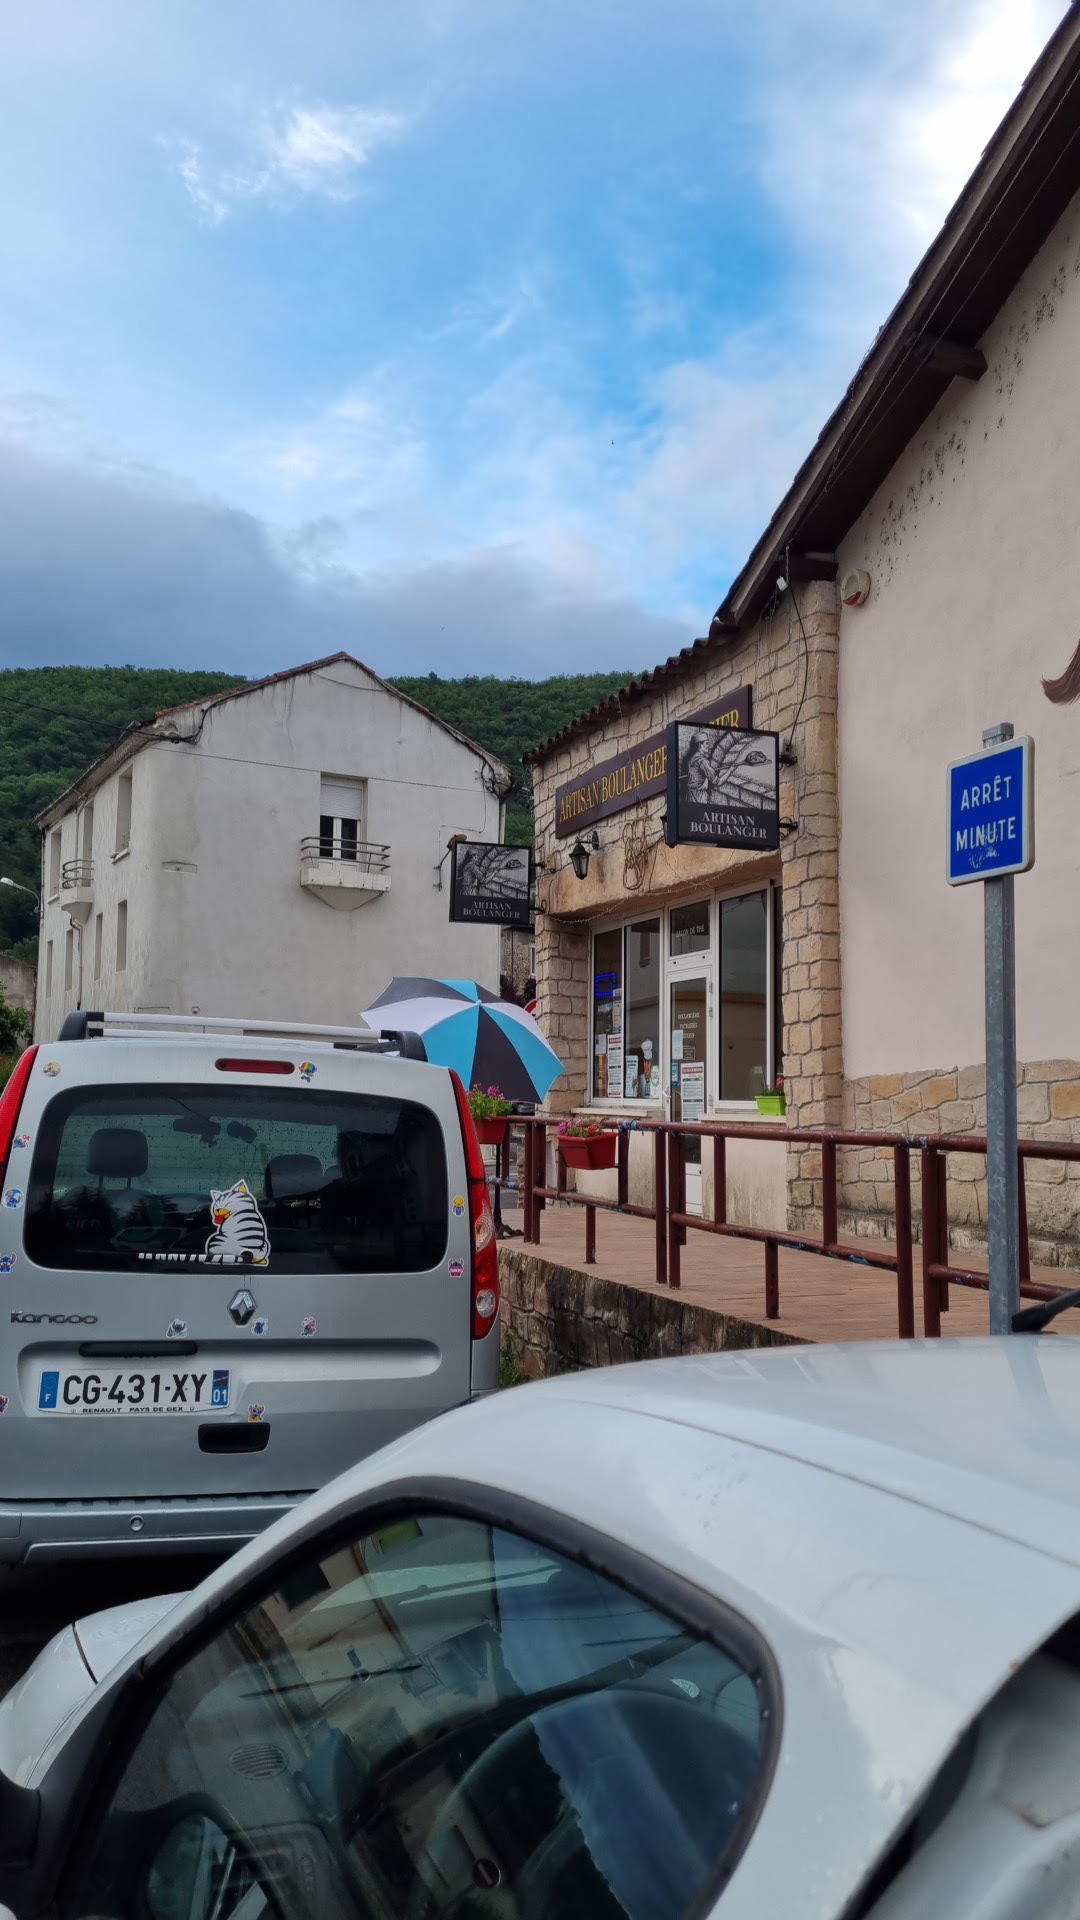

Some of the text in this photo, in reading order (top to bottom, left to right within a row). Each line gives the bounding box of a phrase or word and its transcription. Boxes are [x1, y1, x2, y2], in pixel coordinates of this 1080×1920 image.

[559, 779, 600, 822] ARTISAN
[960, 774, 1012, 811] ARRÊT
[690, 821, 767, 839] BOULANGER
[702, 811, 755, 826] ARTISAN
[956, 816, 1016, 852] MINUTE
[463, 908, 520, 919] BOULANGER
[472, 901, 511, 910] ARTISAN
[44, 1374, 228, 1406] F CG-431-XY 01
